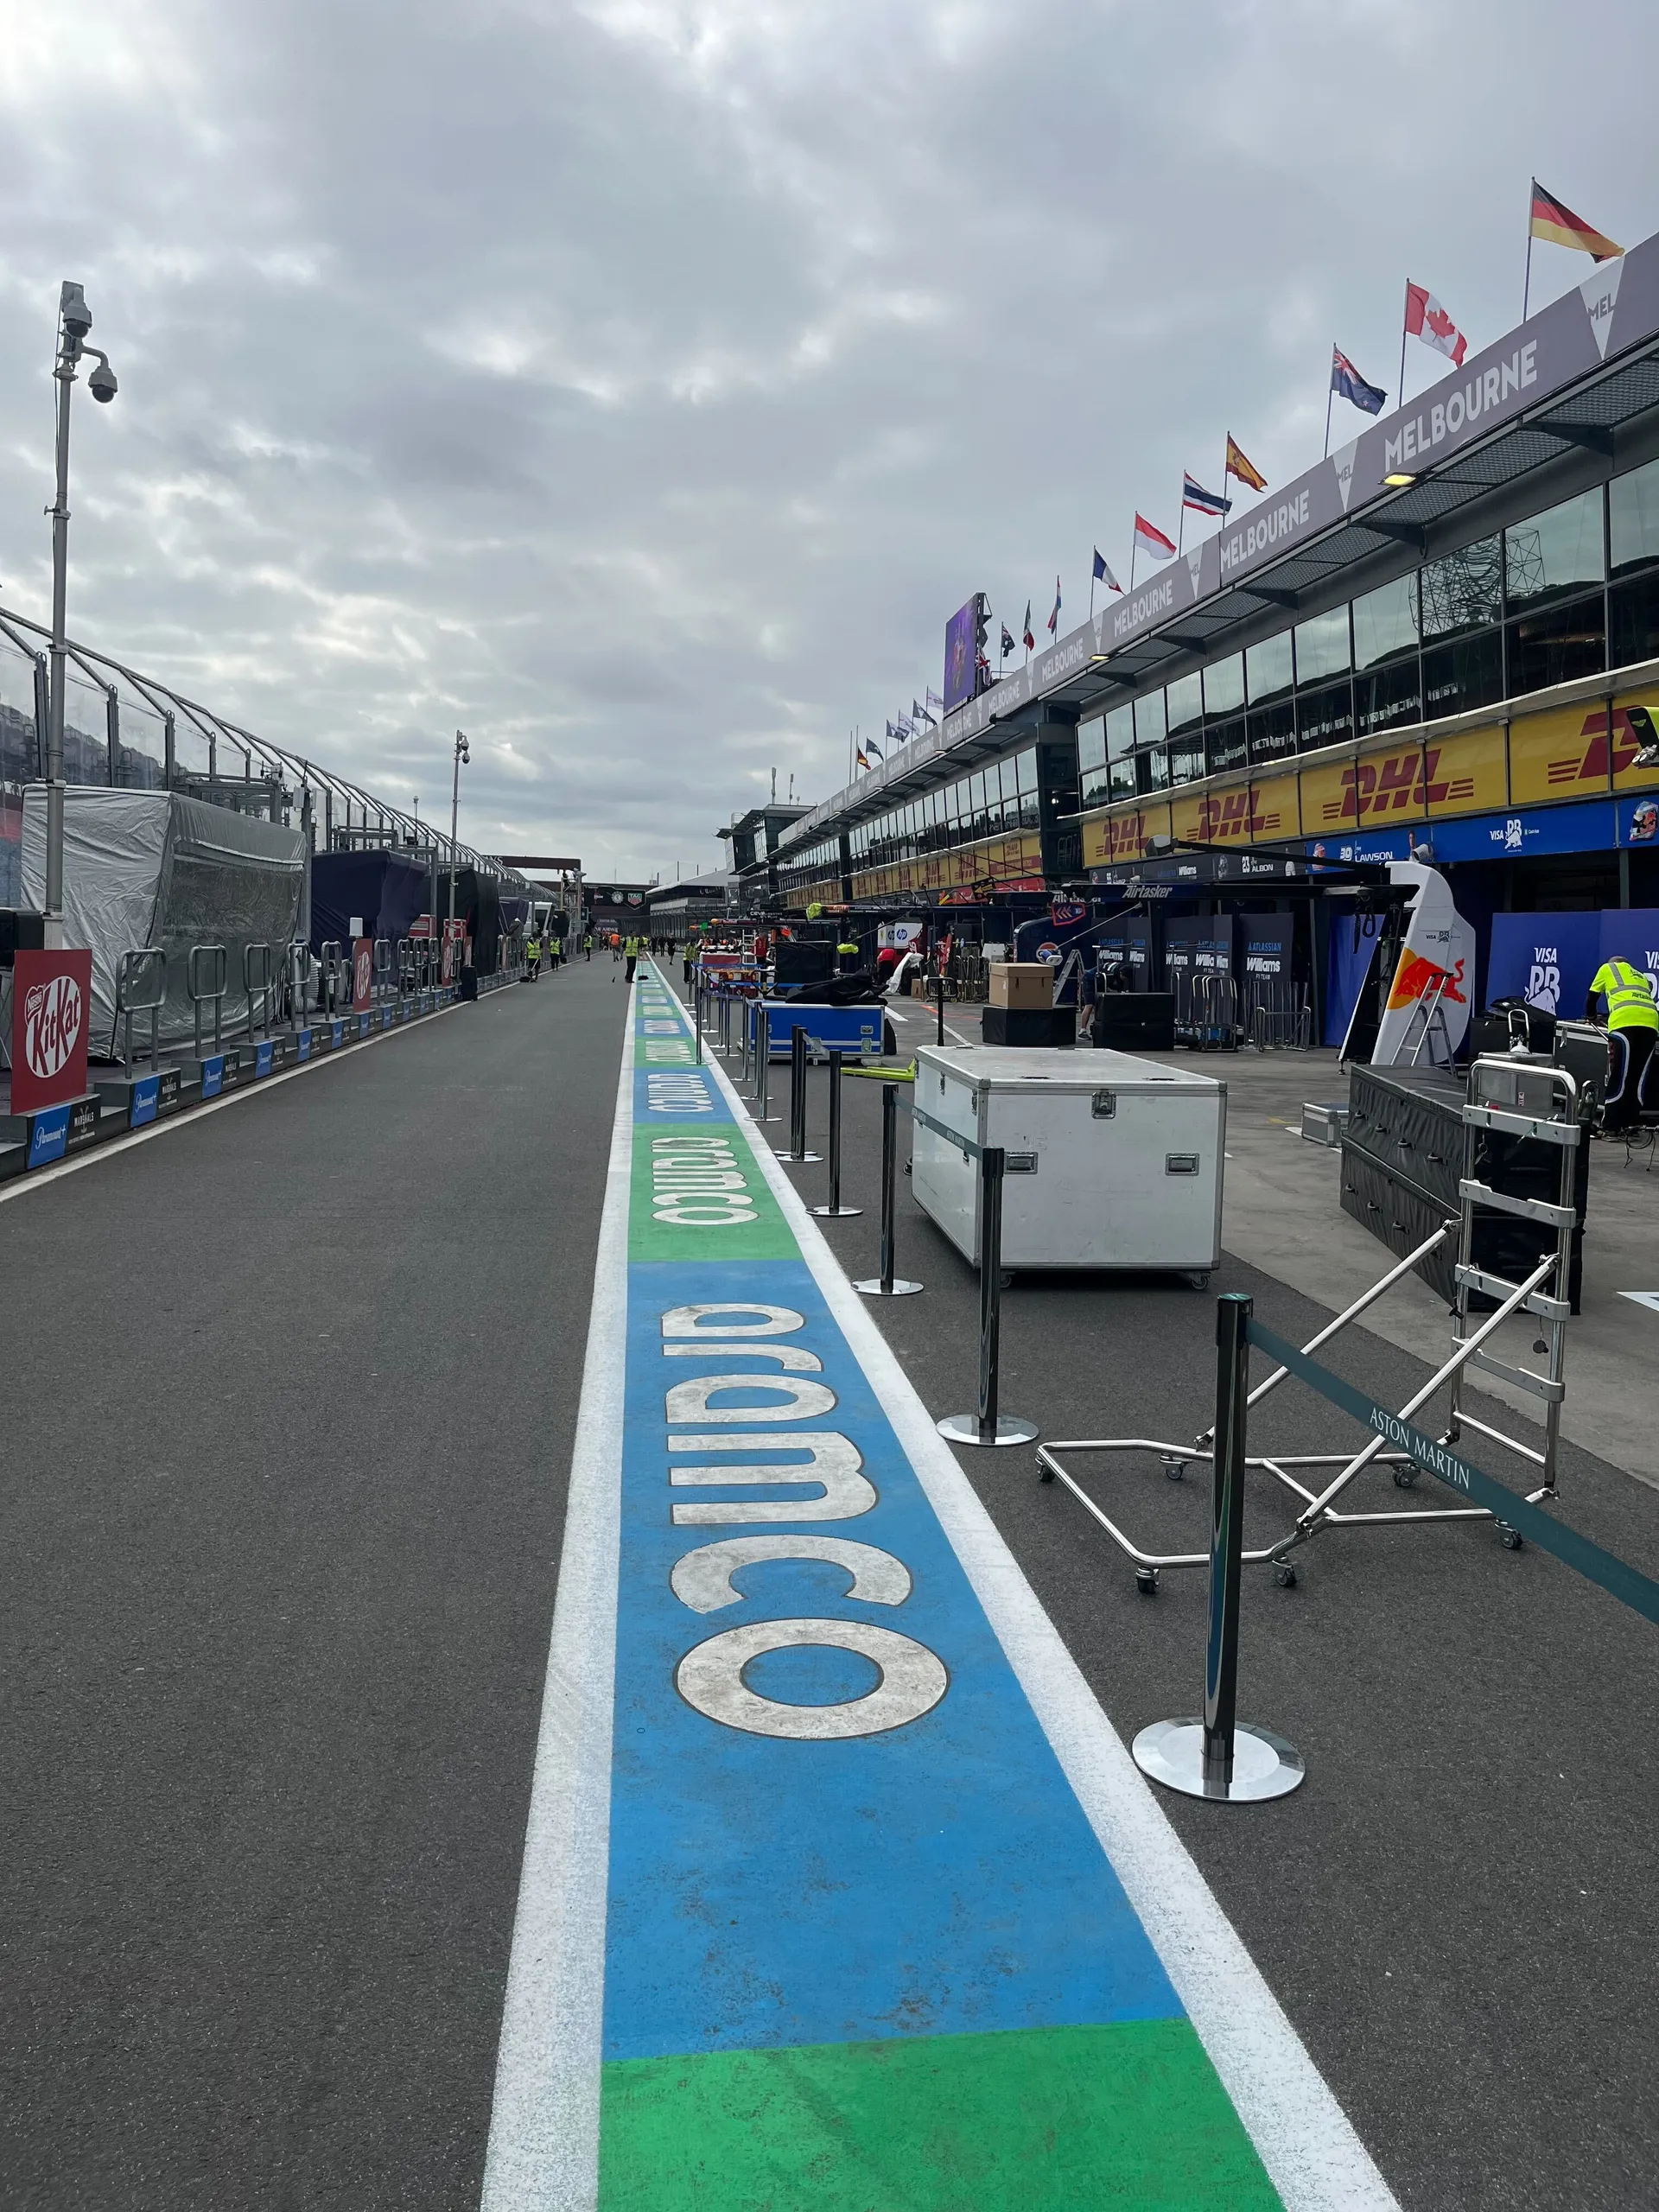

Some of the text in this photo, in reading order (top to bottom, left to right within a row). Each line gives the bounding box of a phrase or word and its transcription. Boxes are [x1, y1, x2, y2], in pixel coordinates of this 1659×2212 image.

[1588, 293, 1616, 321] MEL
[1384, 339, 1538, 472] MELBOURNE
[1220, 489, 1310, 573] MELBOURNE
[1114, 579, 1173, 638] MELBOURNE
[1041, 638, 1084, 683] MELBOURNE
[1339, 748, 1452, 818] DHL
[1197, 790, 1266, 842] DHL
[1103, 815, 1150, 855] DHL
[1489, 830, 1504, 841] VISA
[1242, 855, 1250, 873] 23
[1251, 863, 1274, 873] ALBON
[1339, 846, 1393, 863] 30 LAWSON
[1122, 886, 1173, 899] Airtasker
[898, 929, 908, 940] hp
[1252, 942, 1281, 951] ATLASSIAN
[1196, 954, 1214, 967] Willia
[1246, 957, 1281, 972] Williams
[1534, 947, 1557, 963] VISA
[33, 978, 79, 1076] KitKat
[35, 1124, 66, 1150] Paramount+
[652, 1136, 760, 1225] aramco
[1370, 1407, 1470, 1491] ASTON MARTIN
[661, 1303, 950, 1740] aramco
